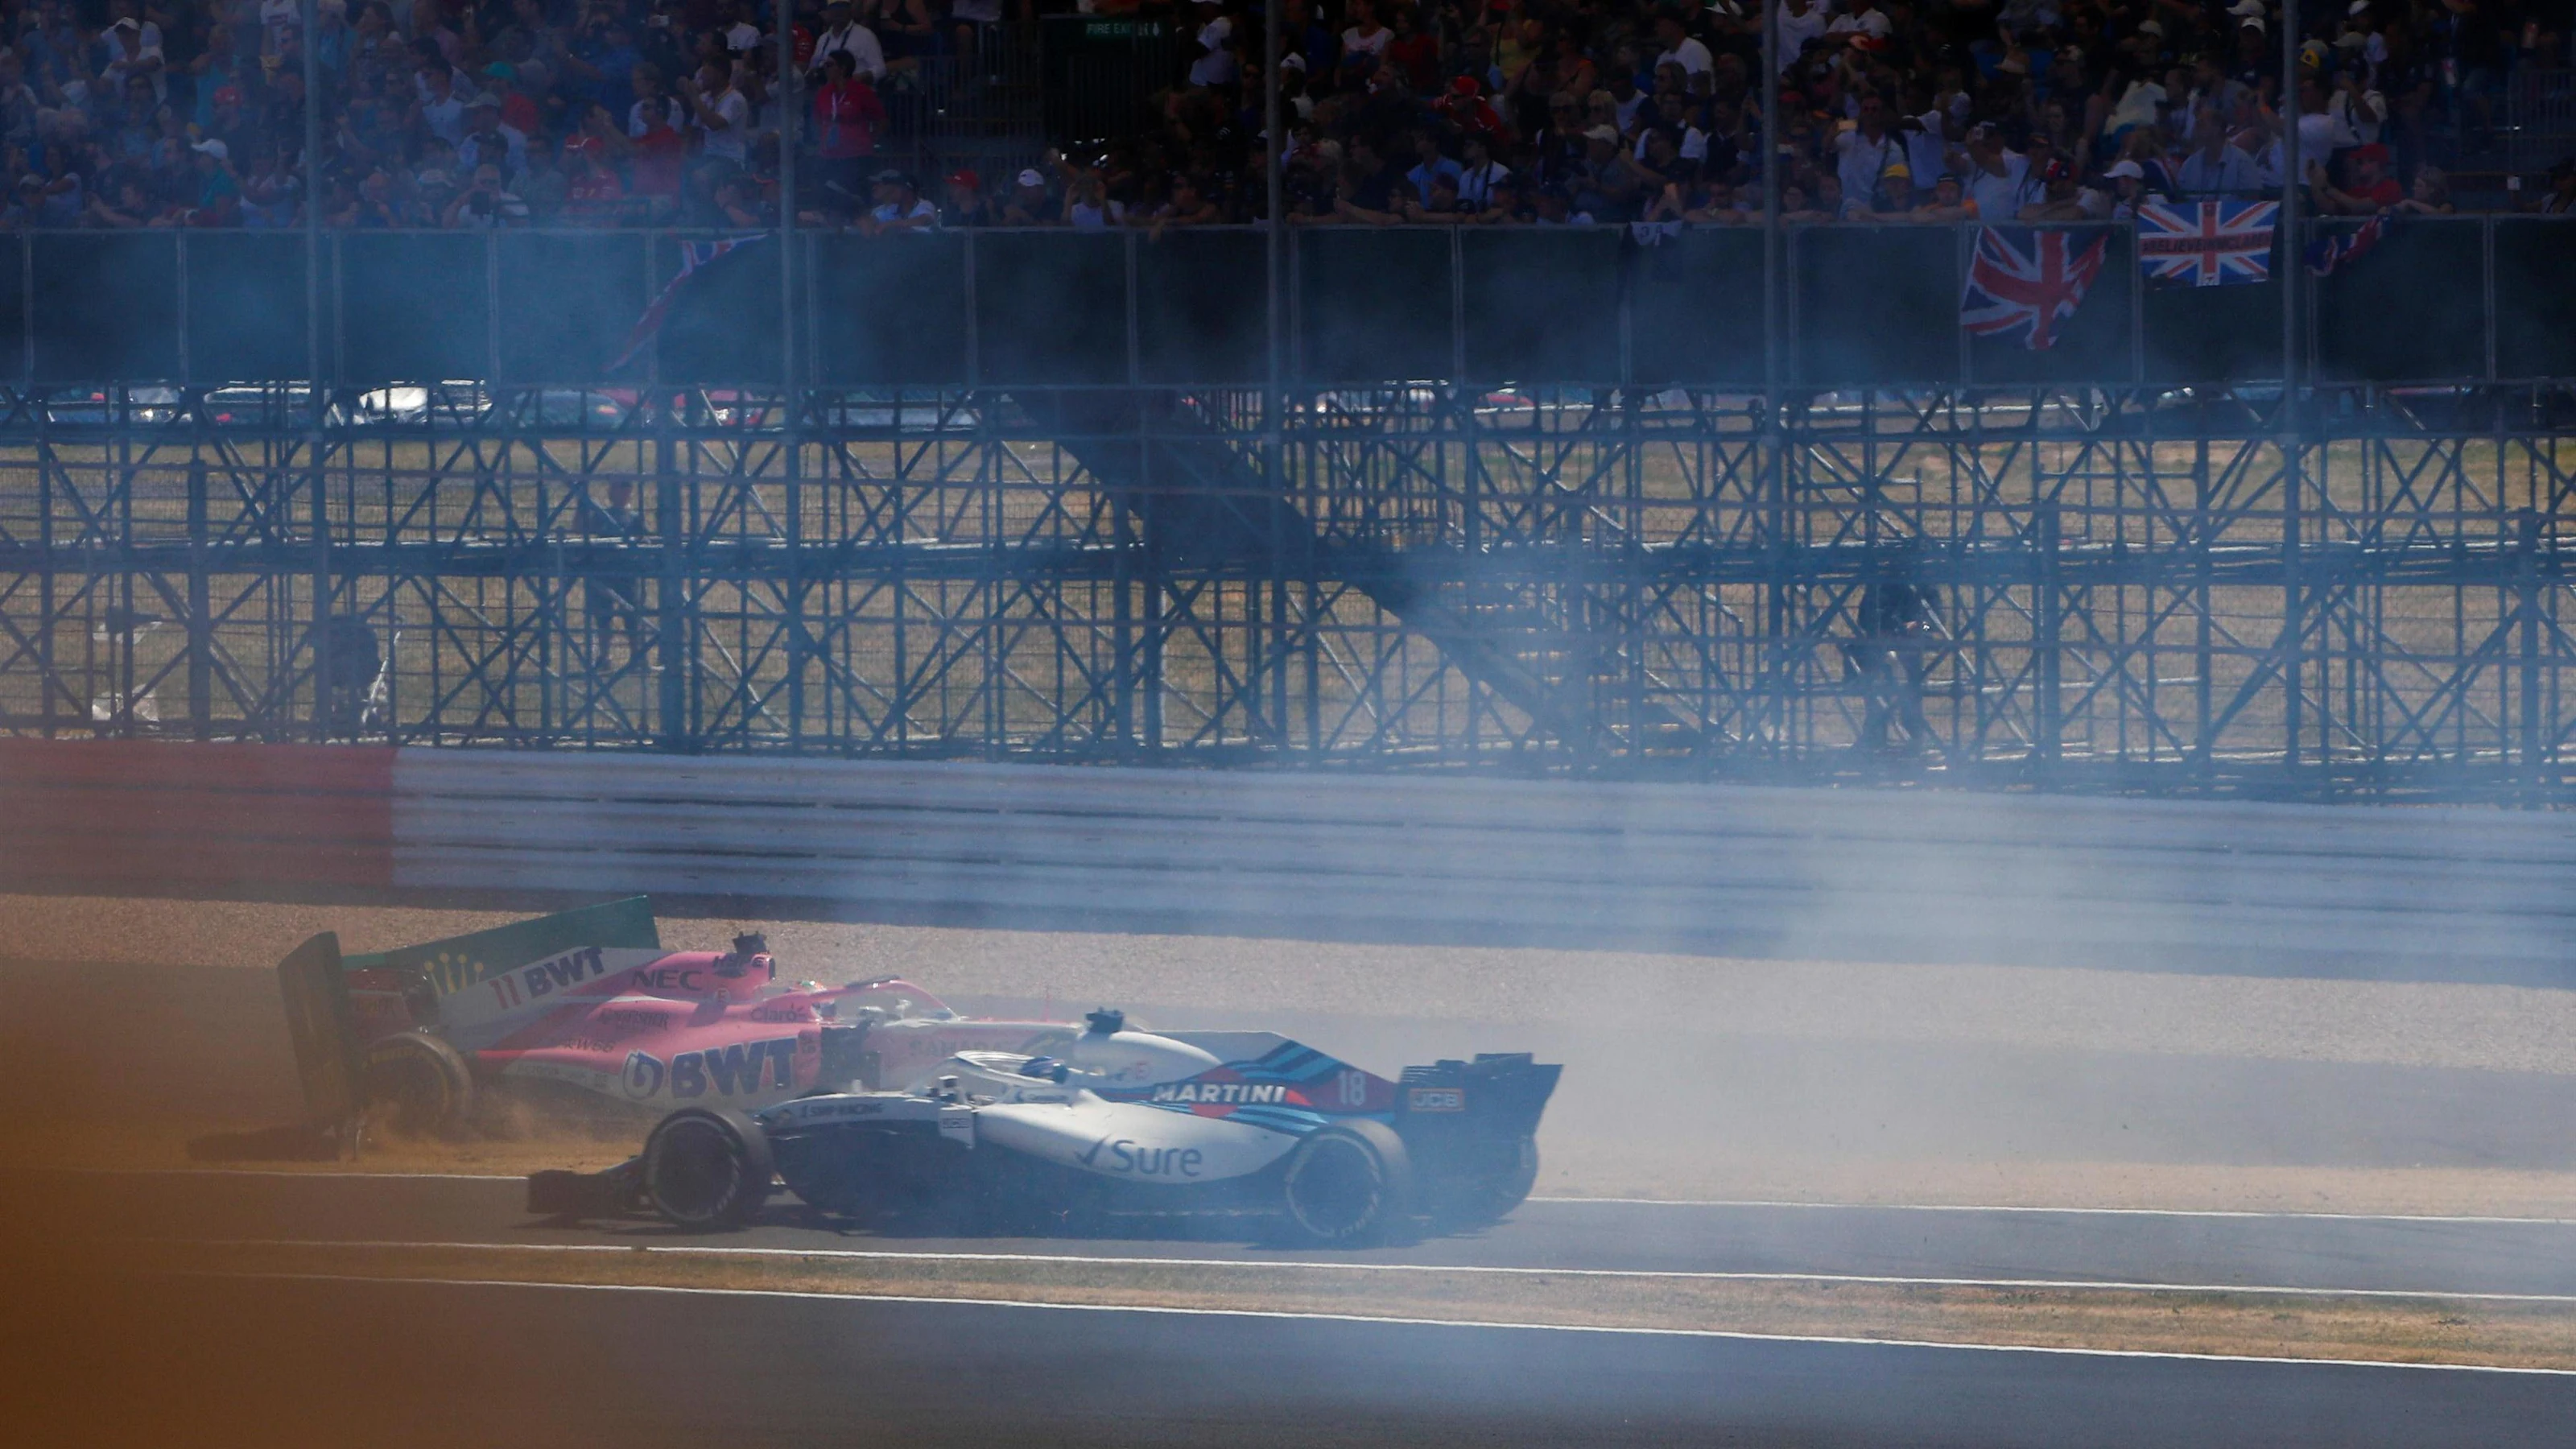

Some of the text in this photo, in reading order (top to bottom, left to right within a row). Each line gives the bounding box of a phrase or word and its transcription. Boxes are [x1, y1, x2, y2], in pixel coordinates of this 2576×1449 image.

[1086, 23, 1111, 35] FIRE
[523, 947, 605, 1000] BWT
[631, 969, 703, 992] NEC
[489, 973, 522, 1011] 11
[751, 1007, 798, 1022] Claro
[671, 1038, 799, 1099] BWT
[1153, 1084, 1286, 1104] MARTINI
[1338, 1070, 1367, 1107] 18
[1413, 1092, 1459, 1108] JCB
[1111, 1140, 1203, 1177] Sure
